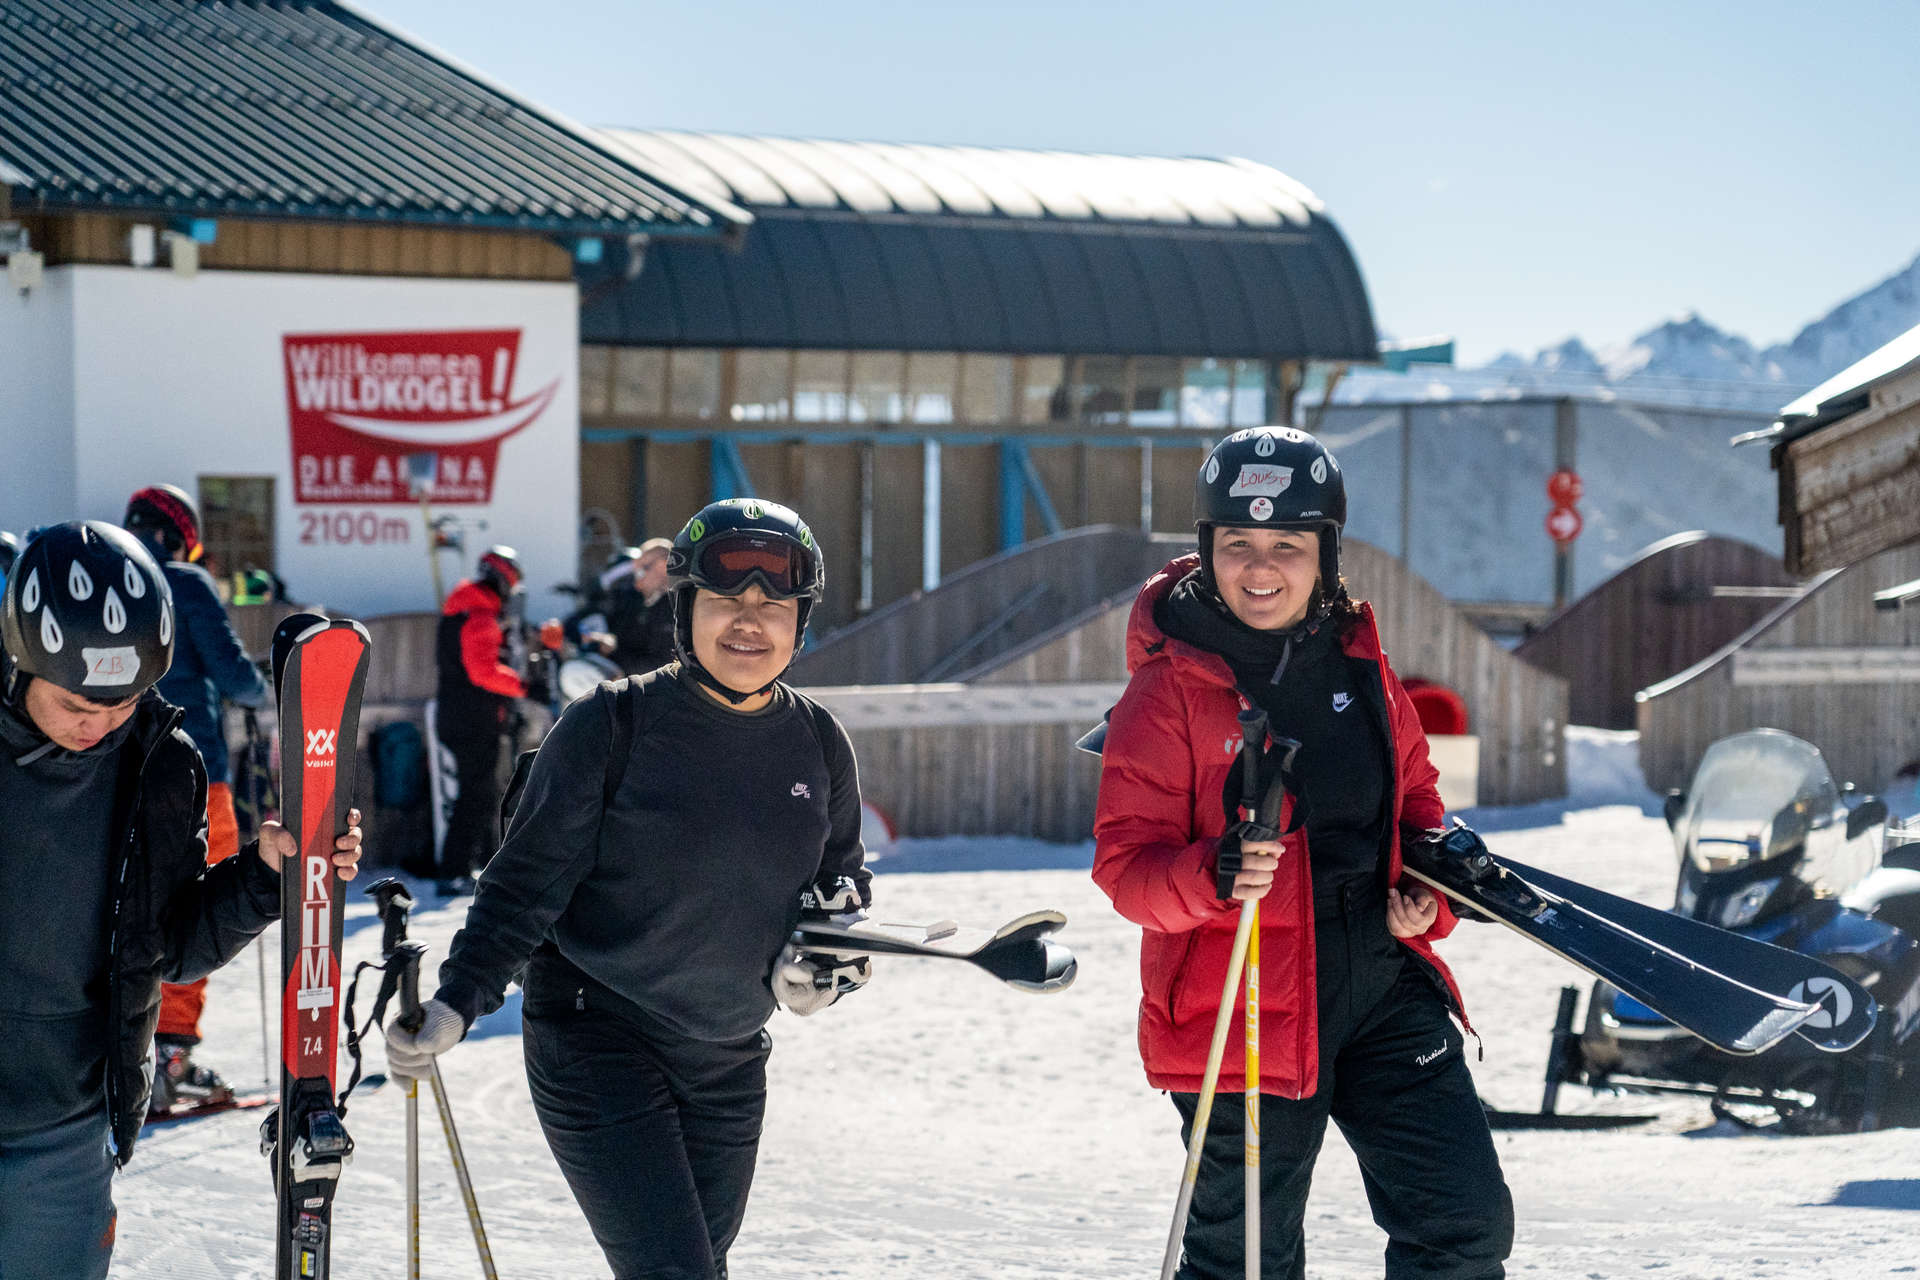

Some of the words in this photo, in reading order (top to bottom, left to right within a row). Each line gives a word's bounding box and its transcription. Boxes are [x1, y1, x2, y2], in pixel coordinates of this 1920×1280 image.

[290, 343, 481, 375] Willkommen
[300, 455, 355, 482] DIE
[299, 512, 410, 544] 2100m
[303, 1037, 323, 1056] 7.4
